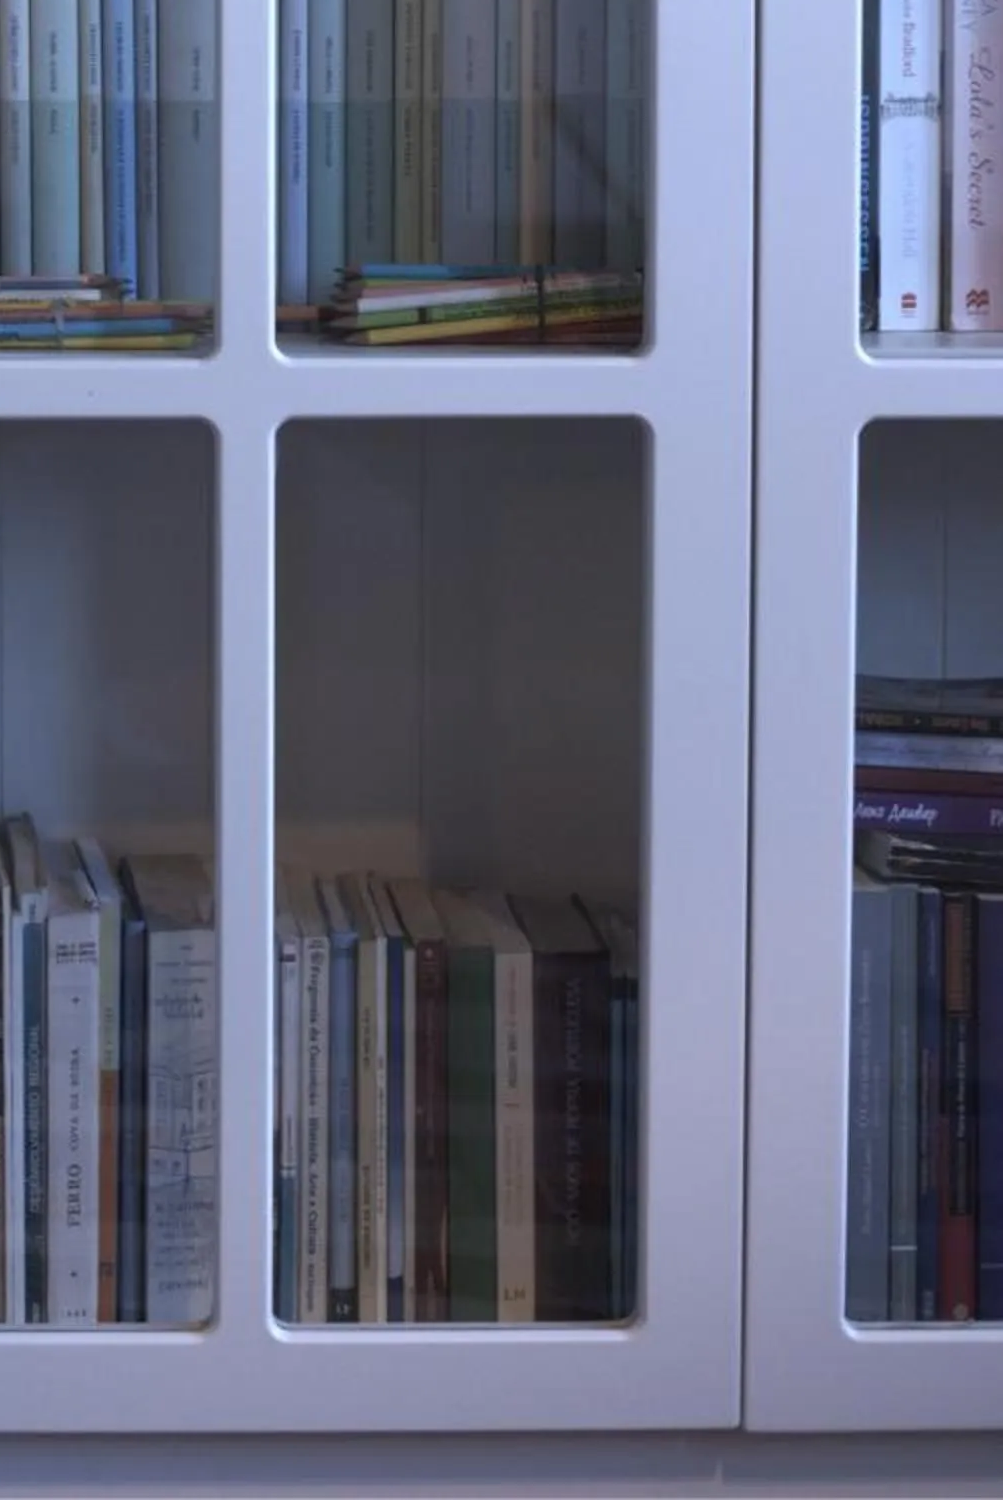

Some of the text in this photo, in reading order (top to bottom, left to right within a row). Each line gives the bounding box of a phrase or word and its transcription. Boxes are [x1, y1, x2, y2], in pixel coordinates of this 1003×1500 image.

[901, 22, 917, 77] Bradford
[967, 47, 995, 230] Lola's Secret
[66, 1163, 82, 1229] FERRO
